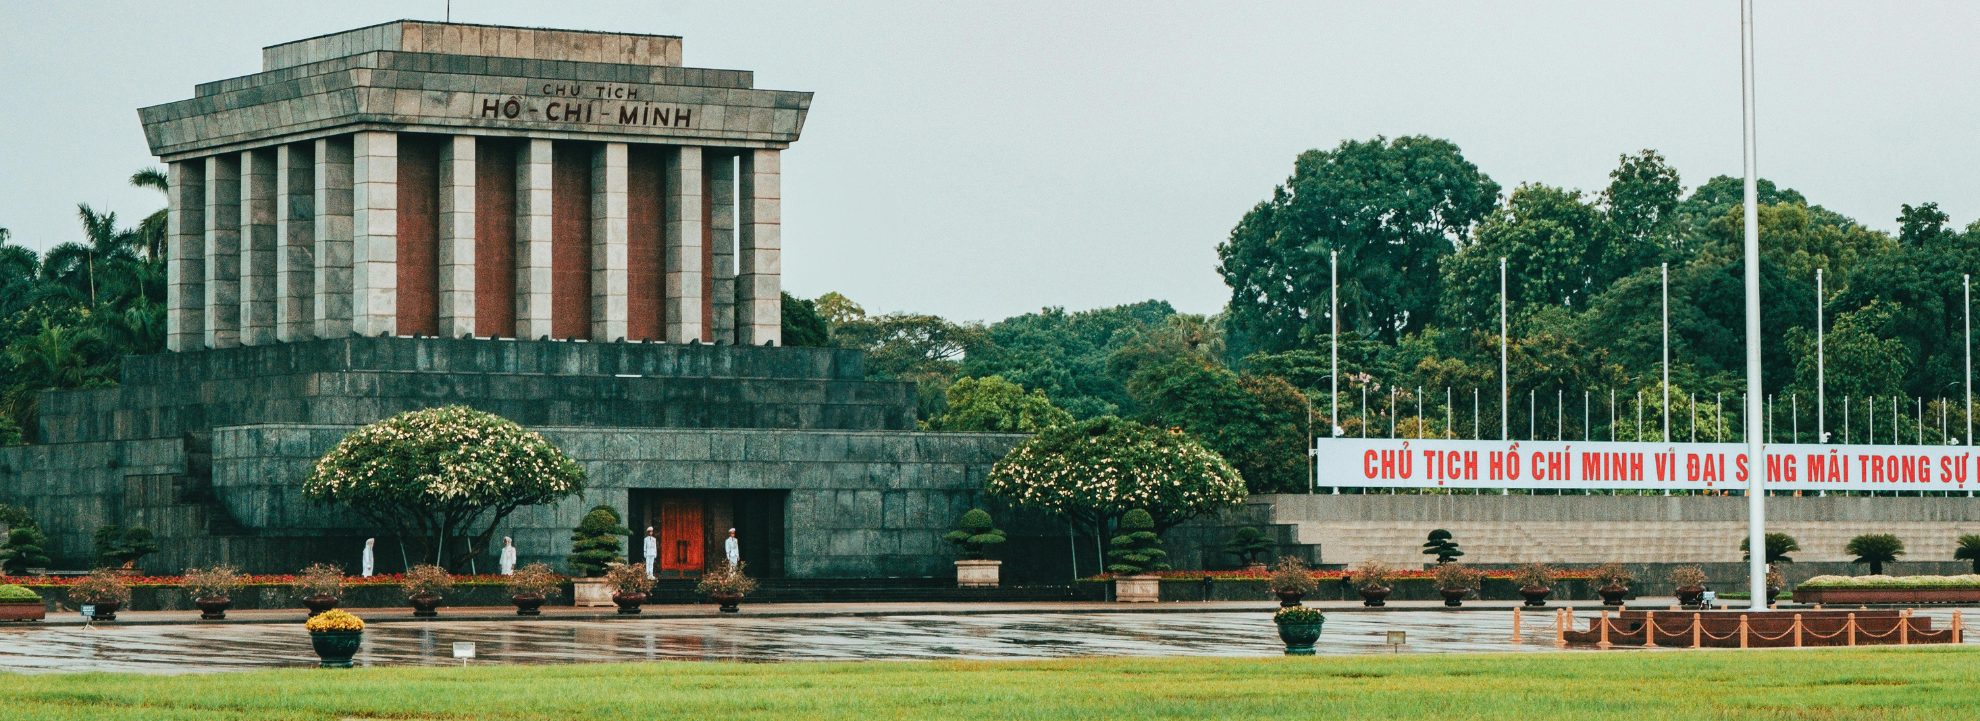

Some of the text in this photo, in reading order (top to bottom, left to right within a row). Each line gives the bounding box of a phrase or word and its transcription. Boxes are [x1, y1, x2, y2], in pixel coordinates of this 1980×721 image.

[1363, 441, 1413, 480] CHỦ
[1423, 450, 1478, 486] TỊCH
[1489, 442, 1520, 481] HỒ
[1531, 445, 1571, 481] CHÍ
[1582, 452, 1644, 481] MINH
[1686, 453, 1725, 487] ĐẠI
[1735, 446, 1797, 483] SNG
[1807, 449, 1849, 483] MÃI
[1858, 455, 1931, 483] TRONG
[1940, 452, 1969, 488] SỰ
